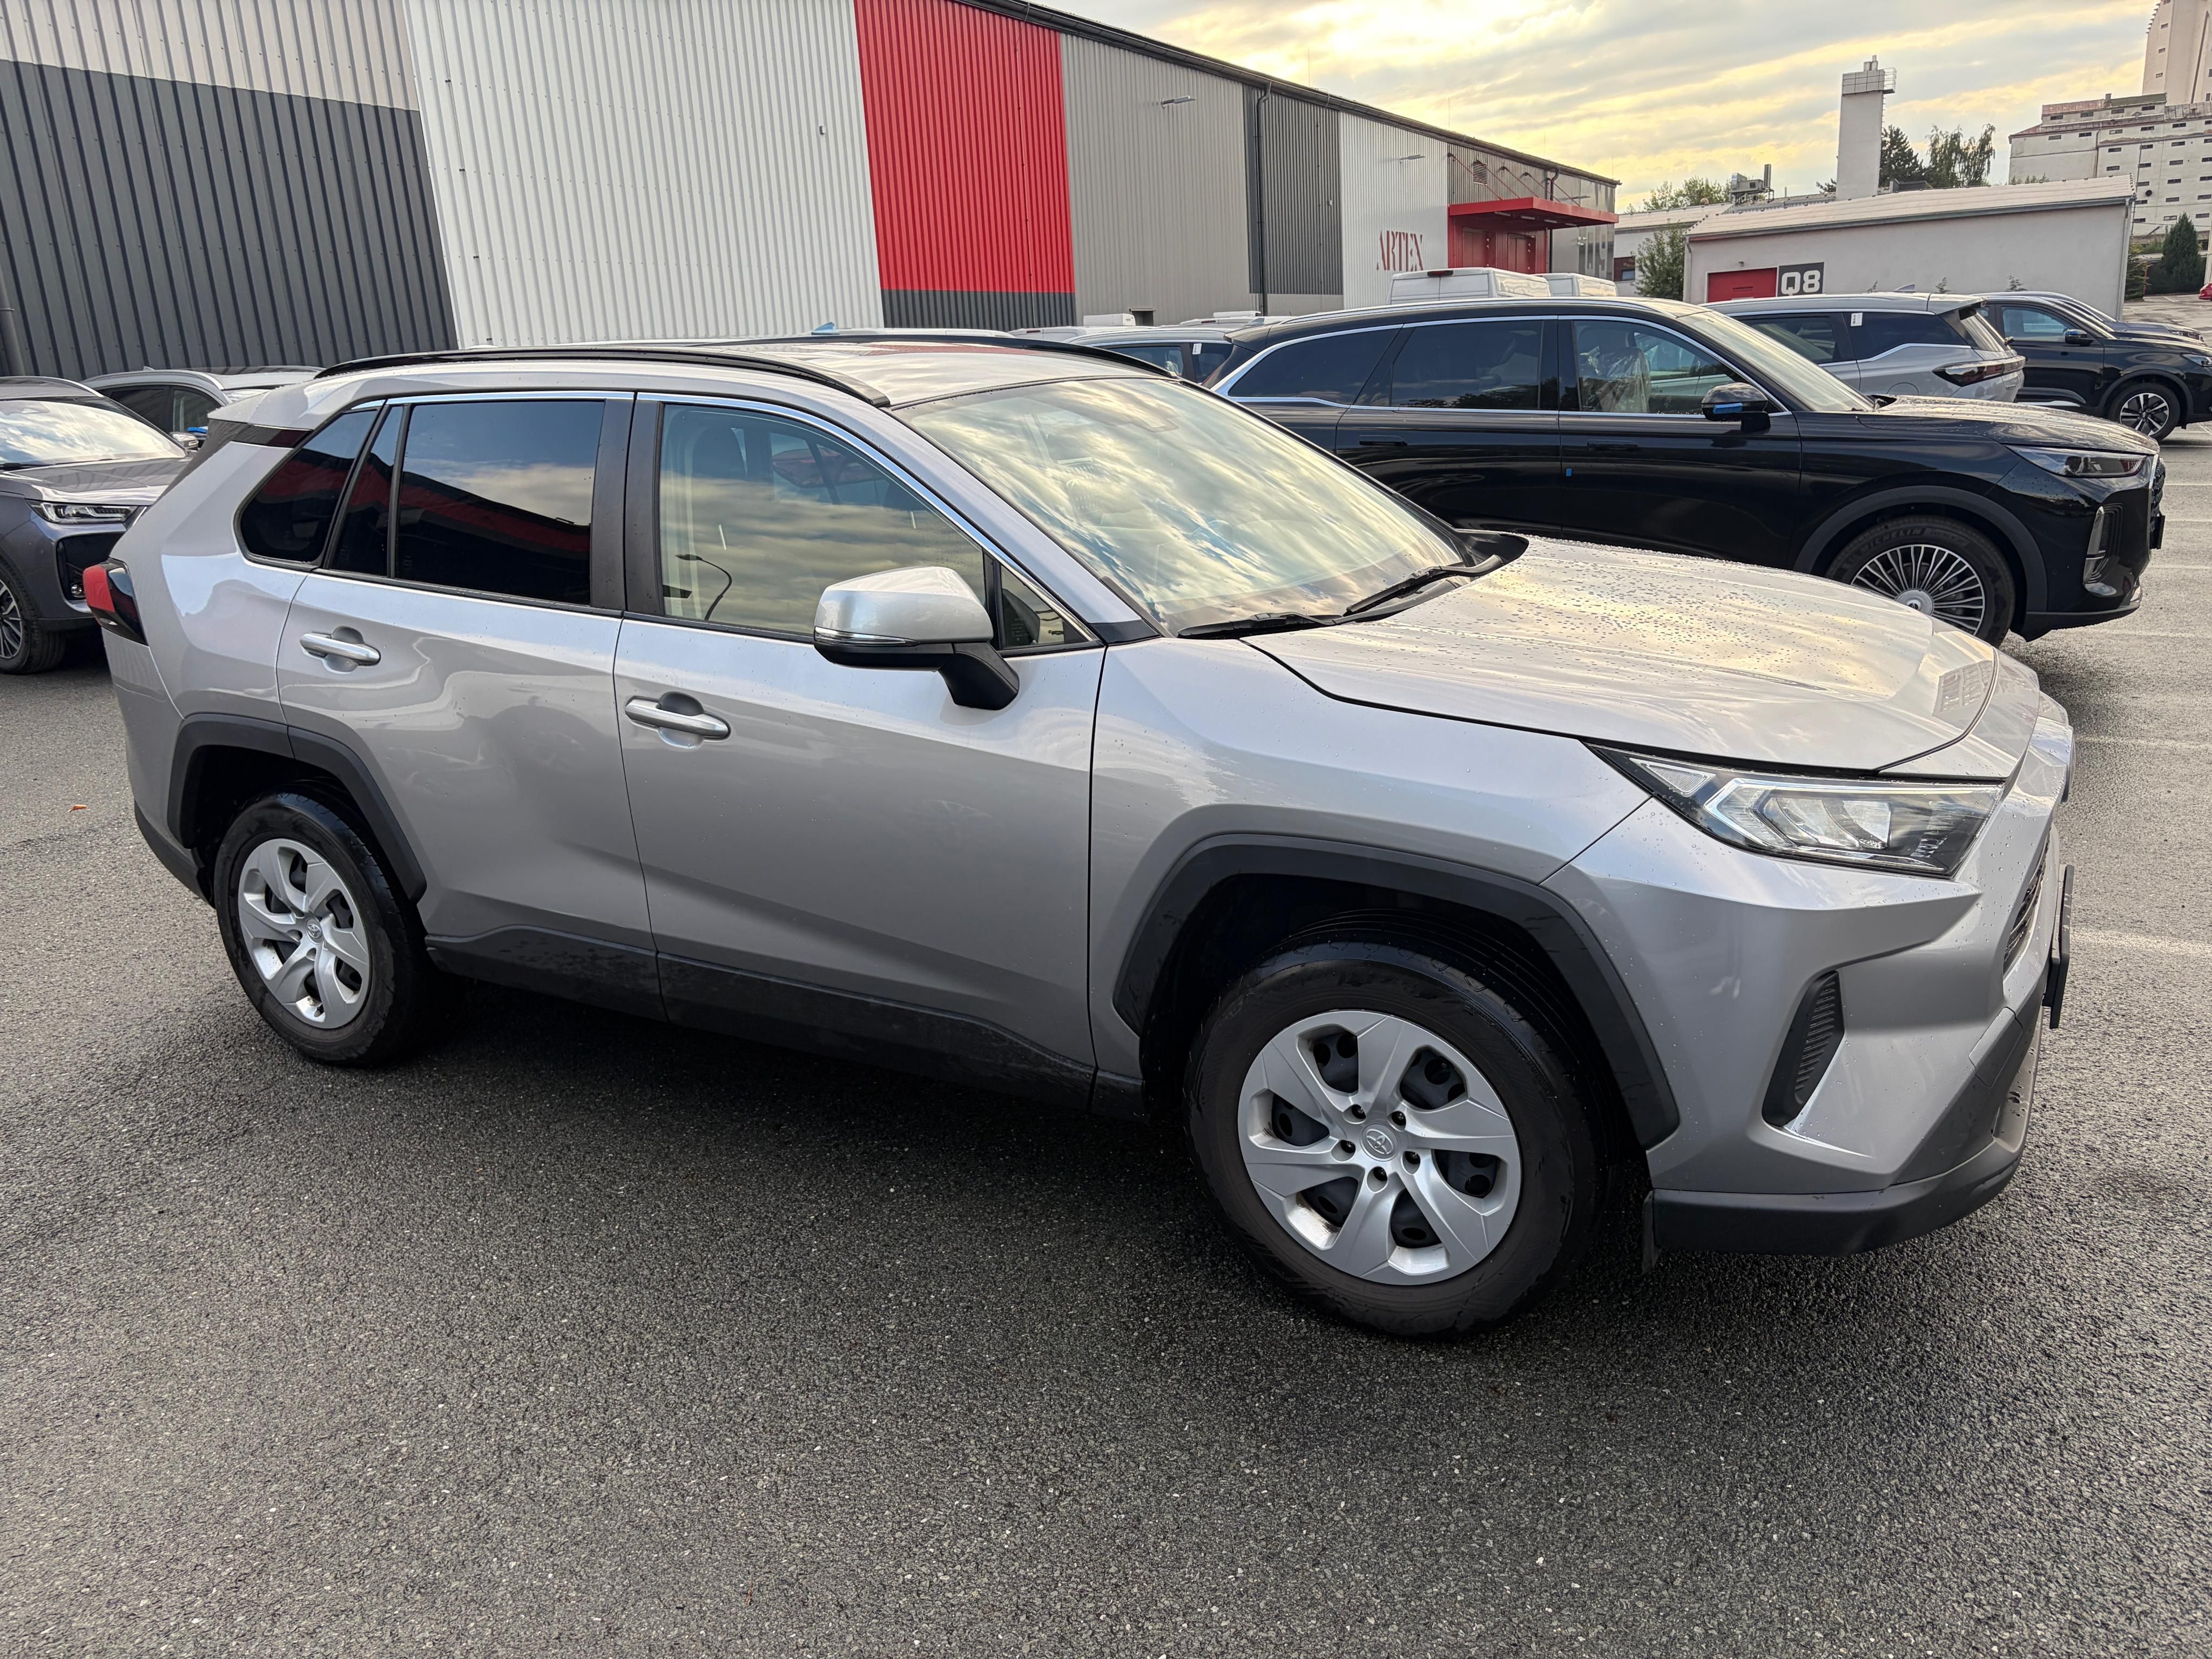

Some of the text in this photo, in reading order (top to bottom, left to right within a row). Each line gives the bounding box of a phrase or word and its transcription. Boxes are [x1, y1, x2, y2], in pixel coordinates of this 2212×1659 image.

[1377, 230, 1423, 272] ARTEX
[1781, 270, 1820, 296] Q8
[1860, 528, 1923, 552] MICHELIN
